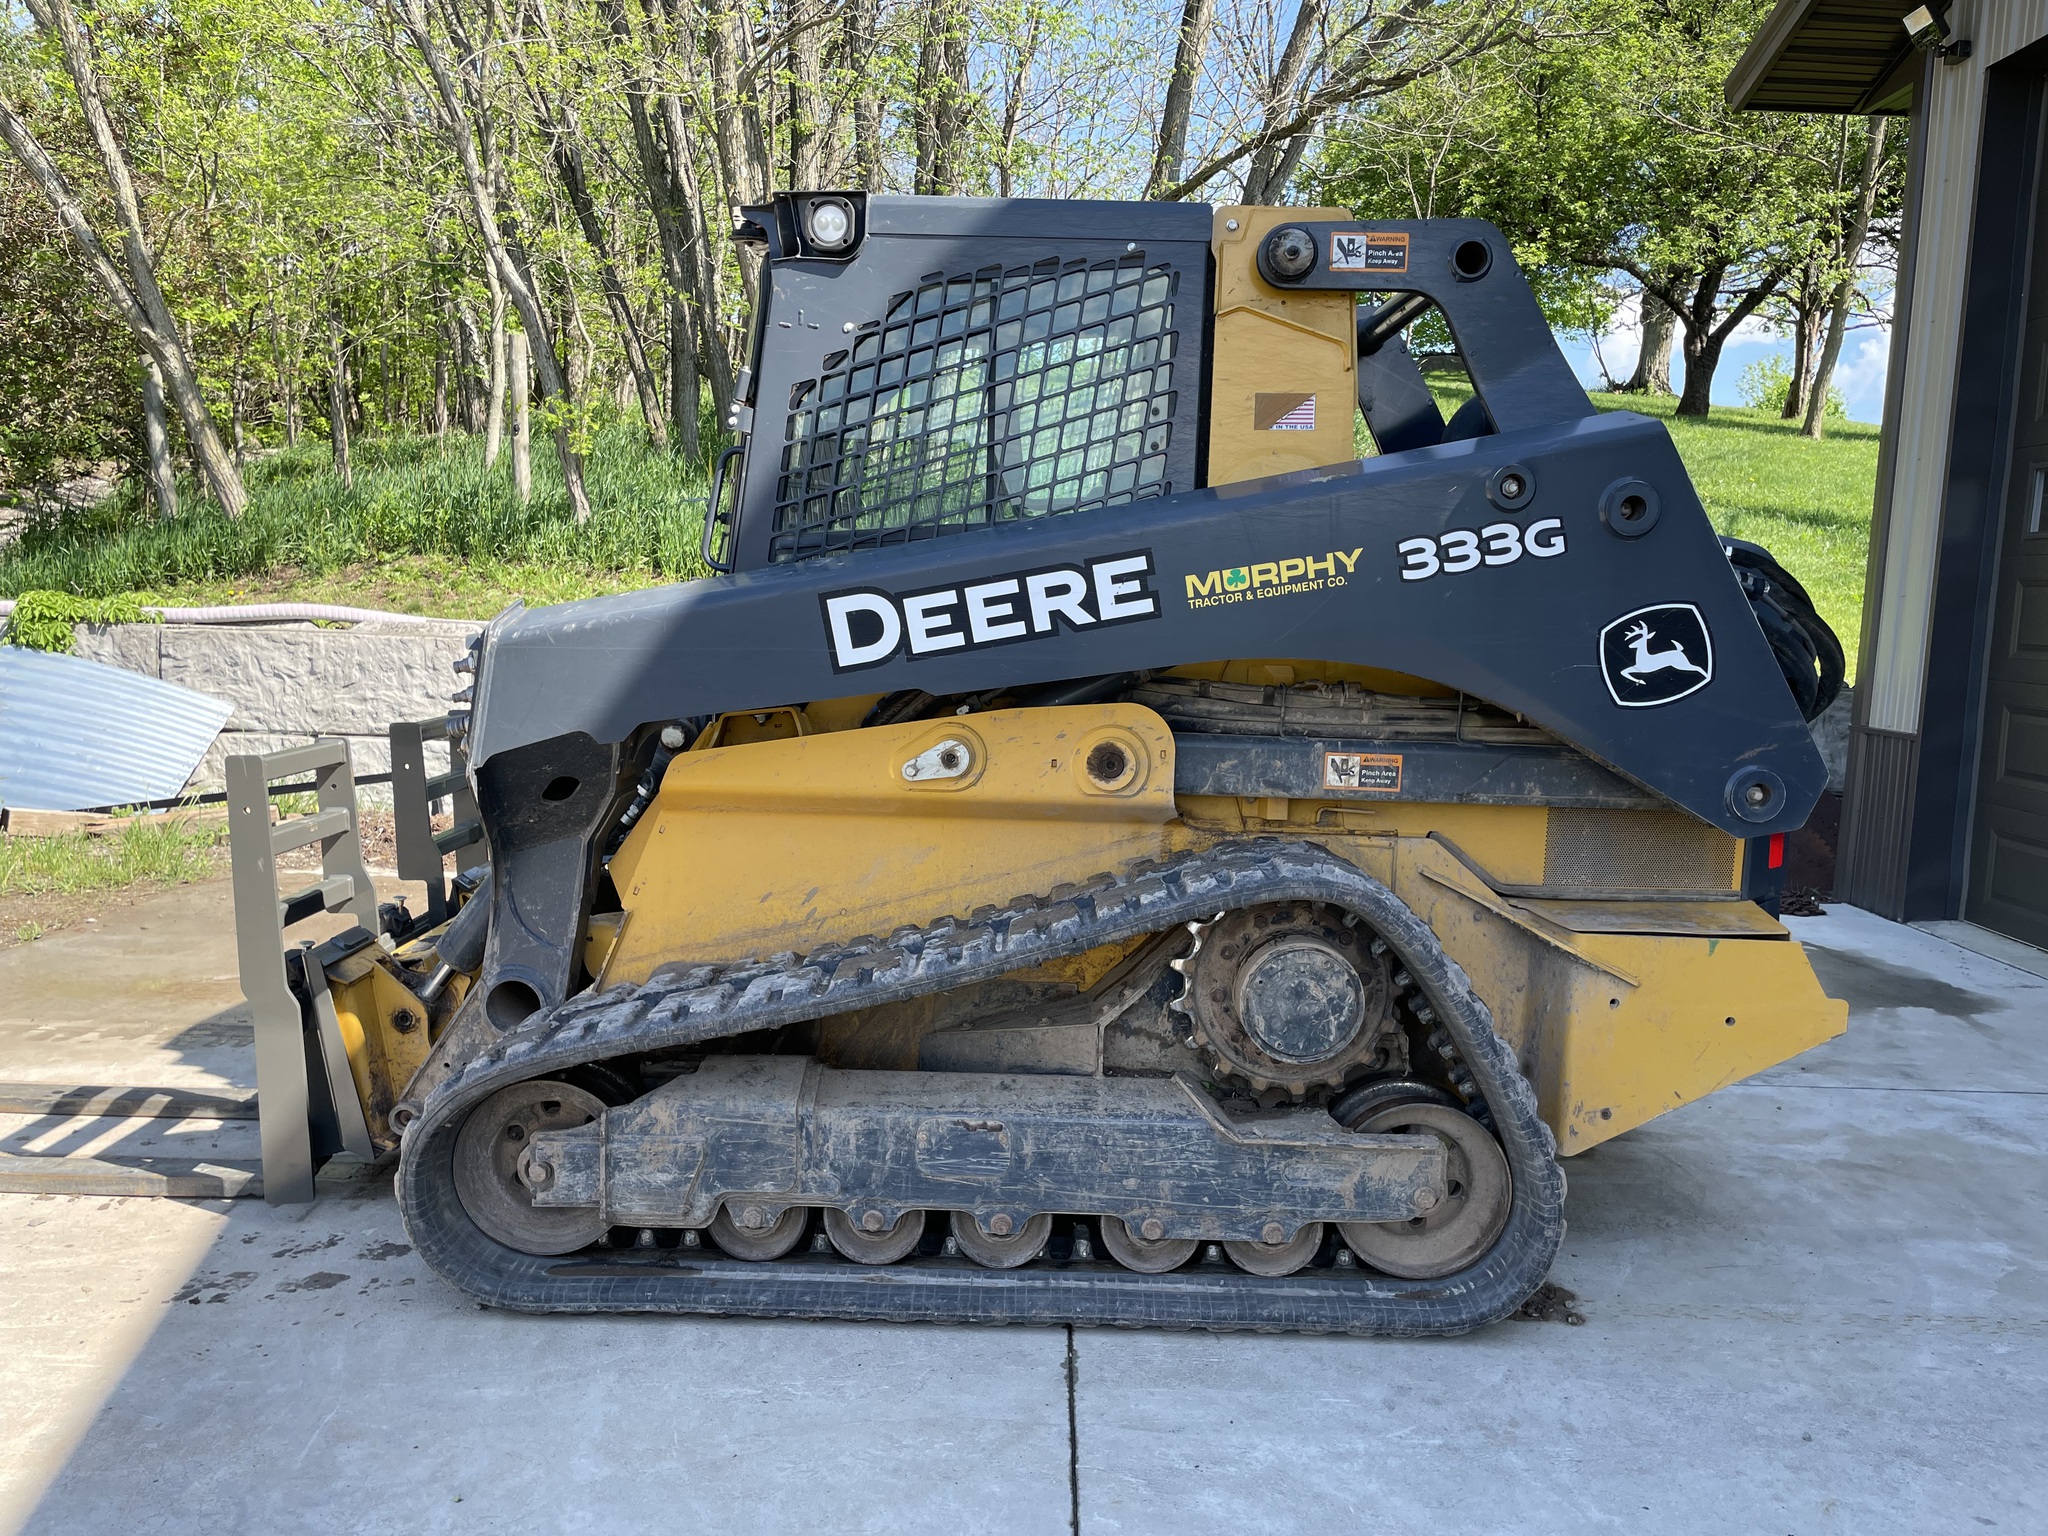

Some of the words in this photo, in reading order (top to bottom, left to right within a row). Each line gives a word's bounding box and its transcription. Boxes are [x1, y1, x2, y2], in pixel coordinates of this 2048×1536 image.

[1184, 547, 1364, 598] MURPHY
[1399, 518, 1566, 580] 333G
[826, 555, 1155, 668] DEERE
[1187, 592, 1243, 609] TRACTOR
[1245, 590, 1254, 600] &
[1256, 579, 1325, 599] EQUIPMENT
[1327, 576, 1348, 588] CO.
